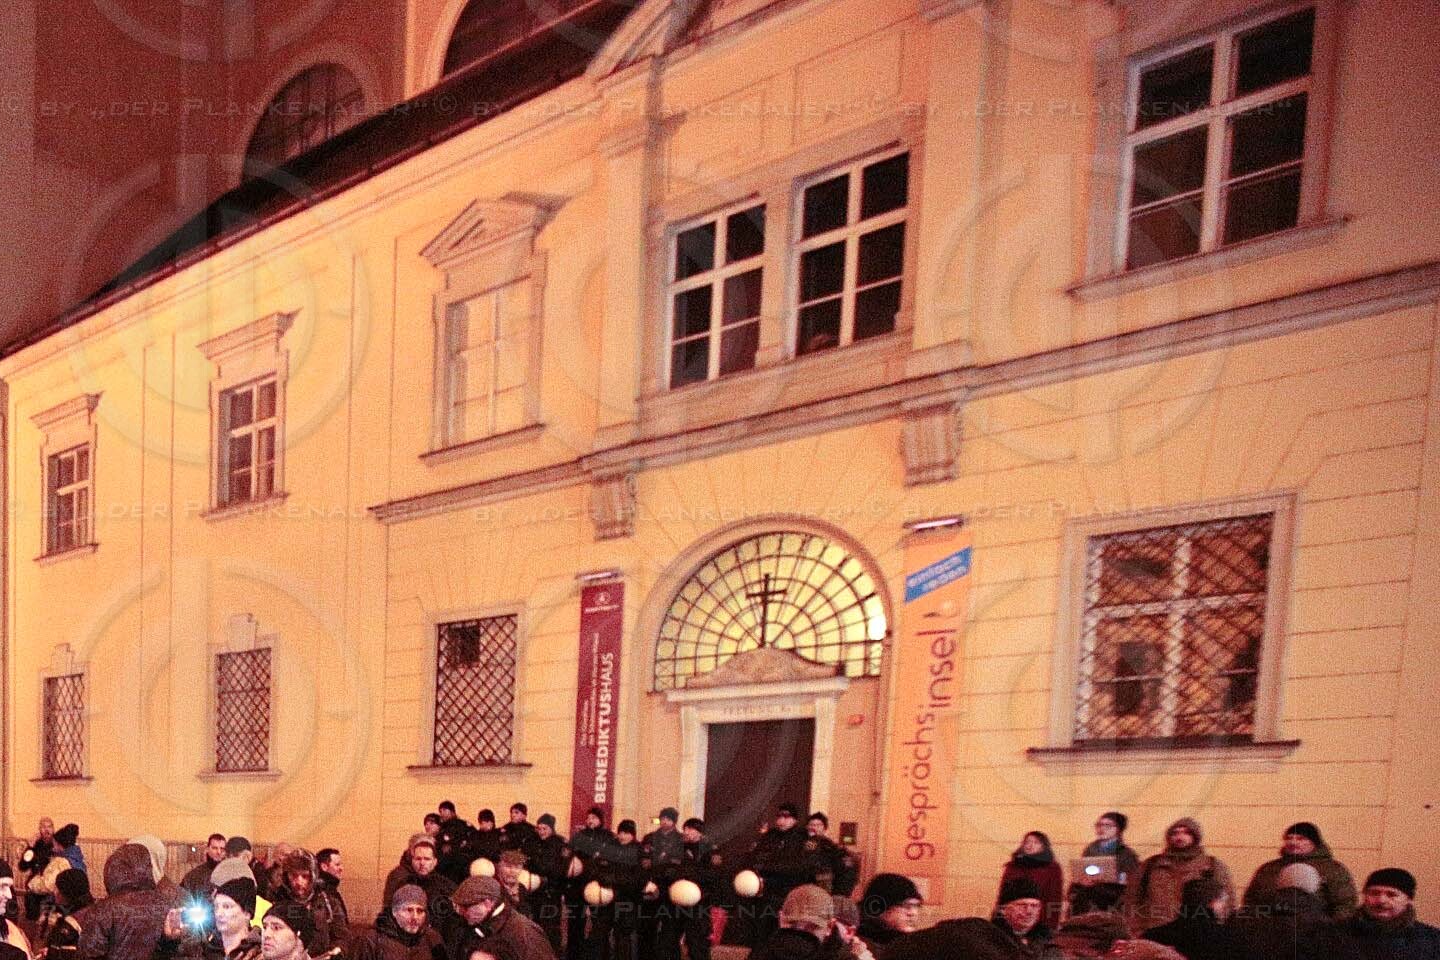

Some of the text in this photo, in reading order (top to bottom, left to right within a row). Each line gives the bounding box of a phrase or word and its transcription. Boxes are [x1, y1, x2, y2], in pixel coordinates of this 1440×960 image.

[593, 651, 614, 804] BENEDIKTUSHAUS
[917, 628, 959, 709] insel
[904, 711, 938, 861] gesprächs
